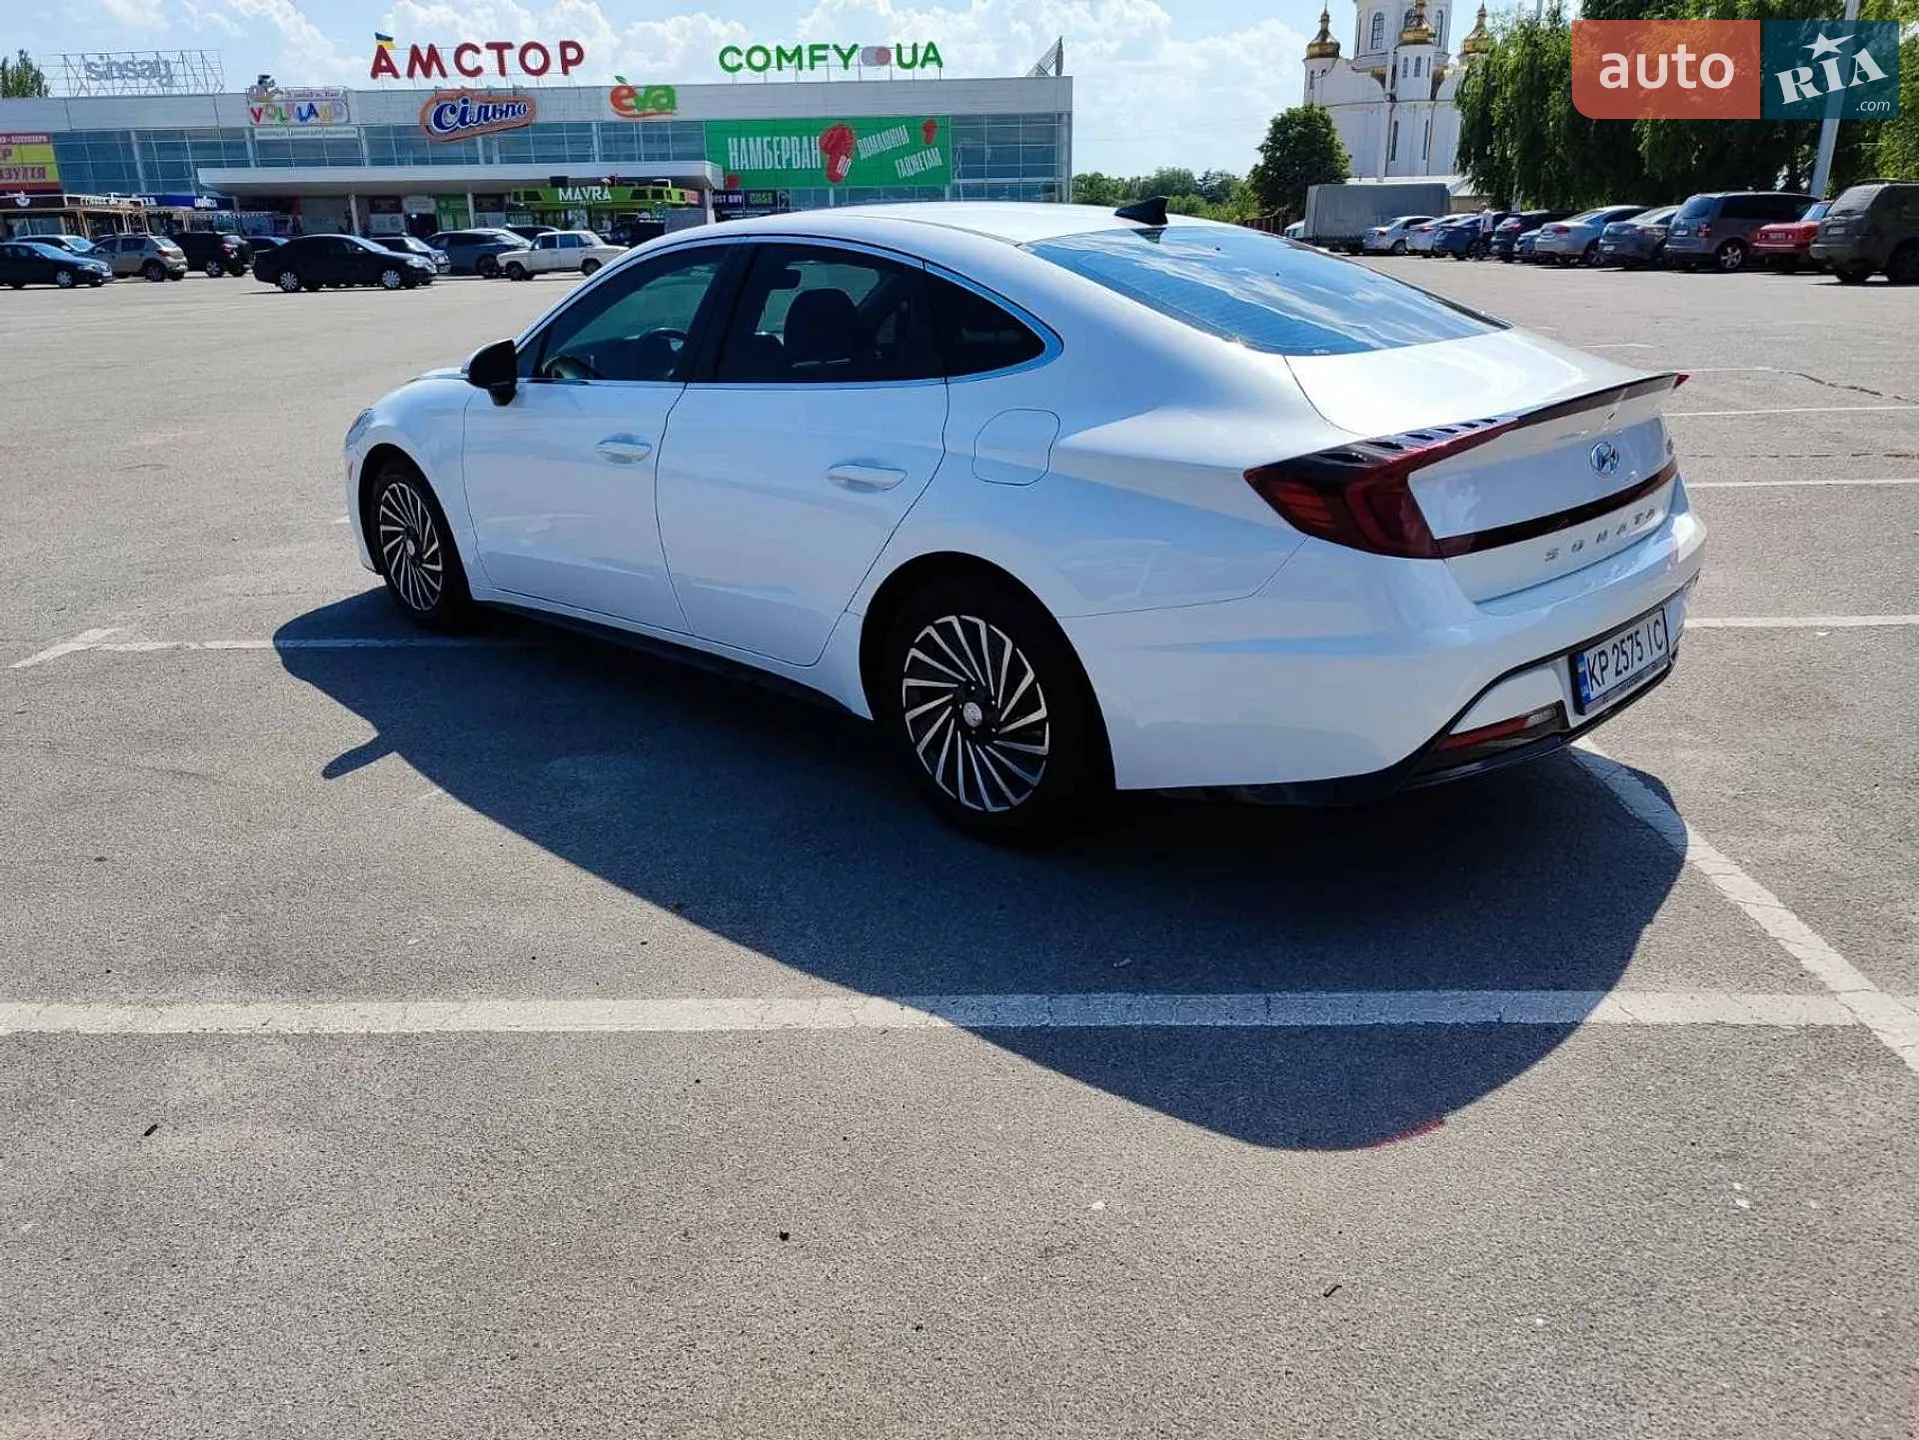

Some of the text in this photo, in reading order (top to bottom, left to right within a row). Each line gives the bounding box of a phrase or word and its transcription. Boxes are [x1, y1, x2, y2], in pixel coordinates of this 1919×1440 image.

[84, 54, 172, 88] sinsay
[370, 39, 585, 79] АМСТОР
[718, 41, 943, 73] COMFY UA
[432, 97, 527, 132] Сільпо
[728, 136, 821, 170] НАМБЕРВАН
[558, 187, 612, 201] MAVRA
[1544, 508, 1656, 562] SONATA
[1586, 650, 1609, 693] KP
[1611, 629, 1645, 677] 2575
[1646, 619, 1664, 656] IC
